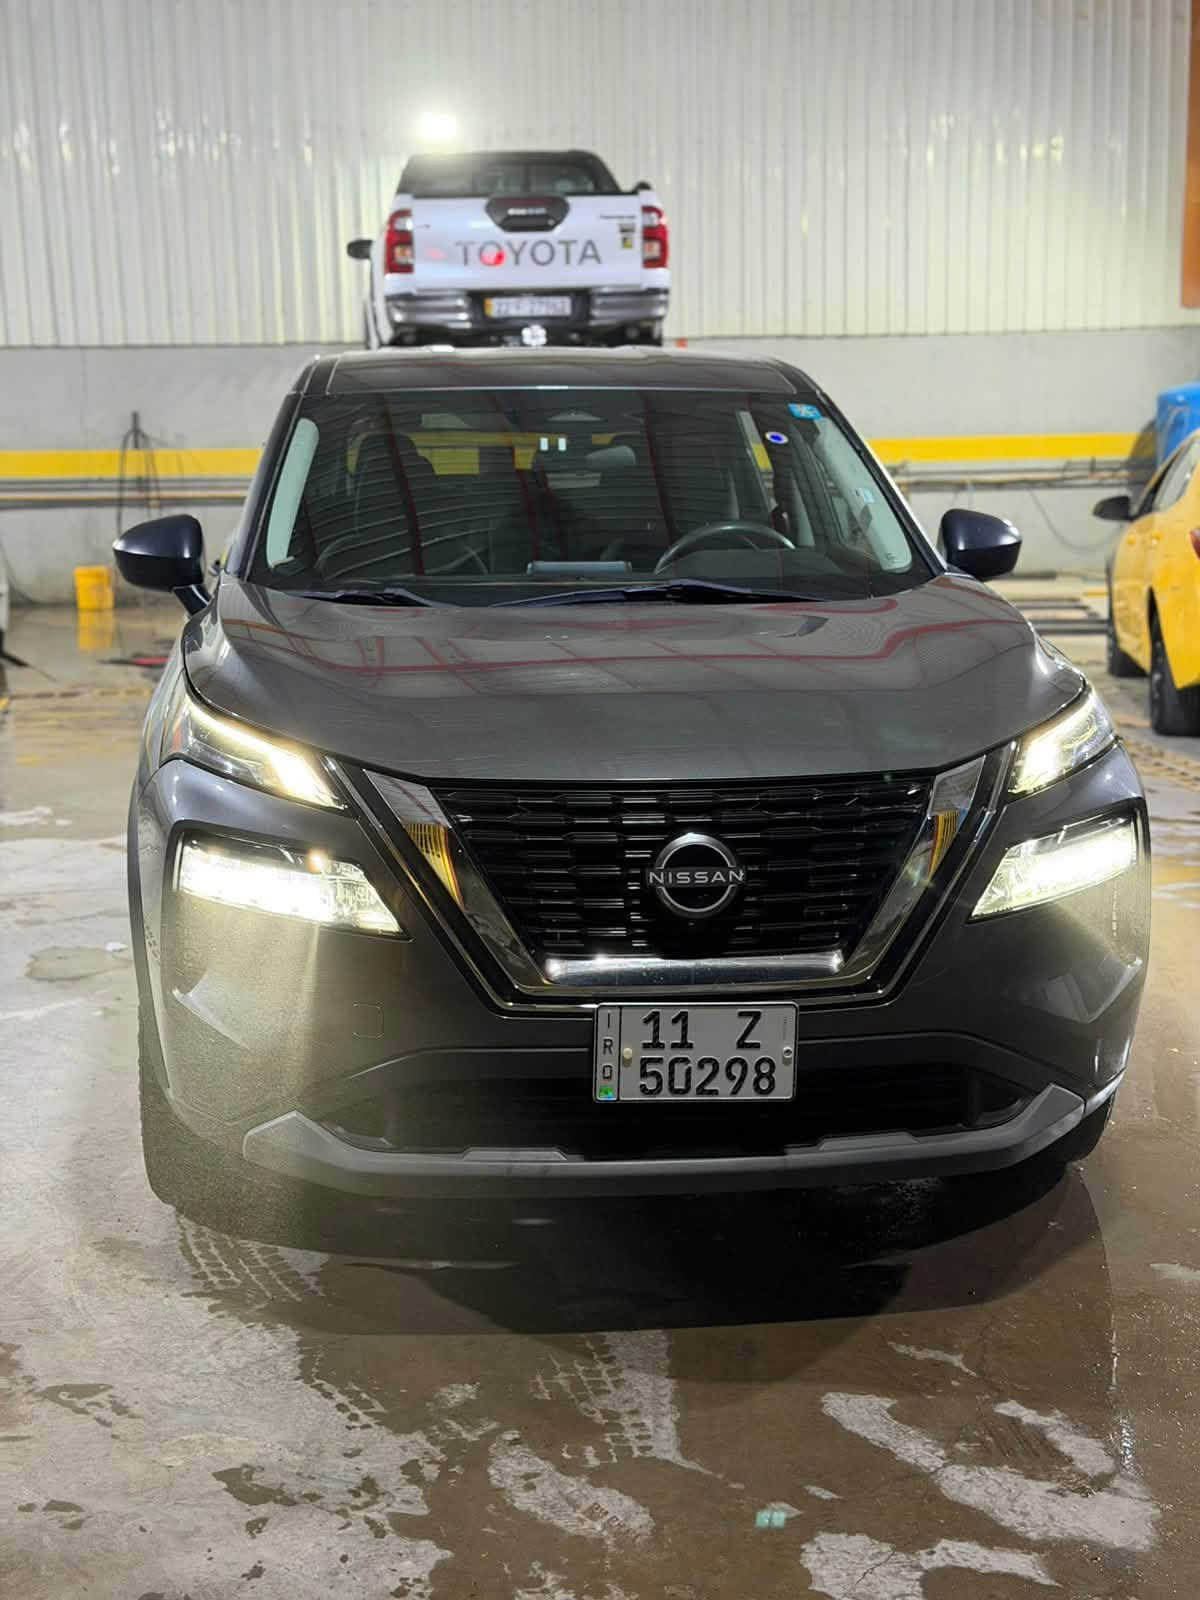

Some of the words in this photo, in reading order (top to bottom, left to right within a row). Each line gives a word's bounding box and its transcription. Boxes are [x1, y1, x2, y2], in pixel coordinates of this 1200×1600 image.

[455, 239, 602, 266] TOYOTA
[649, 869, 744, 884] NISSAN
[641, 1009, 695, 1050] 11
[735, 1010, 762, 1050] Z
[639, 1056, 776, 1096] 50298
